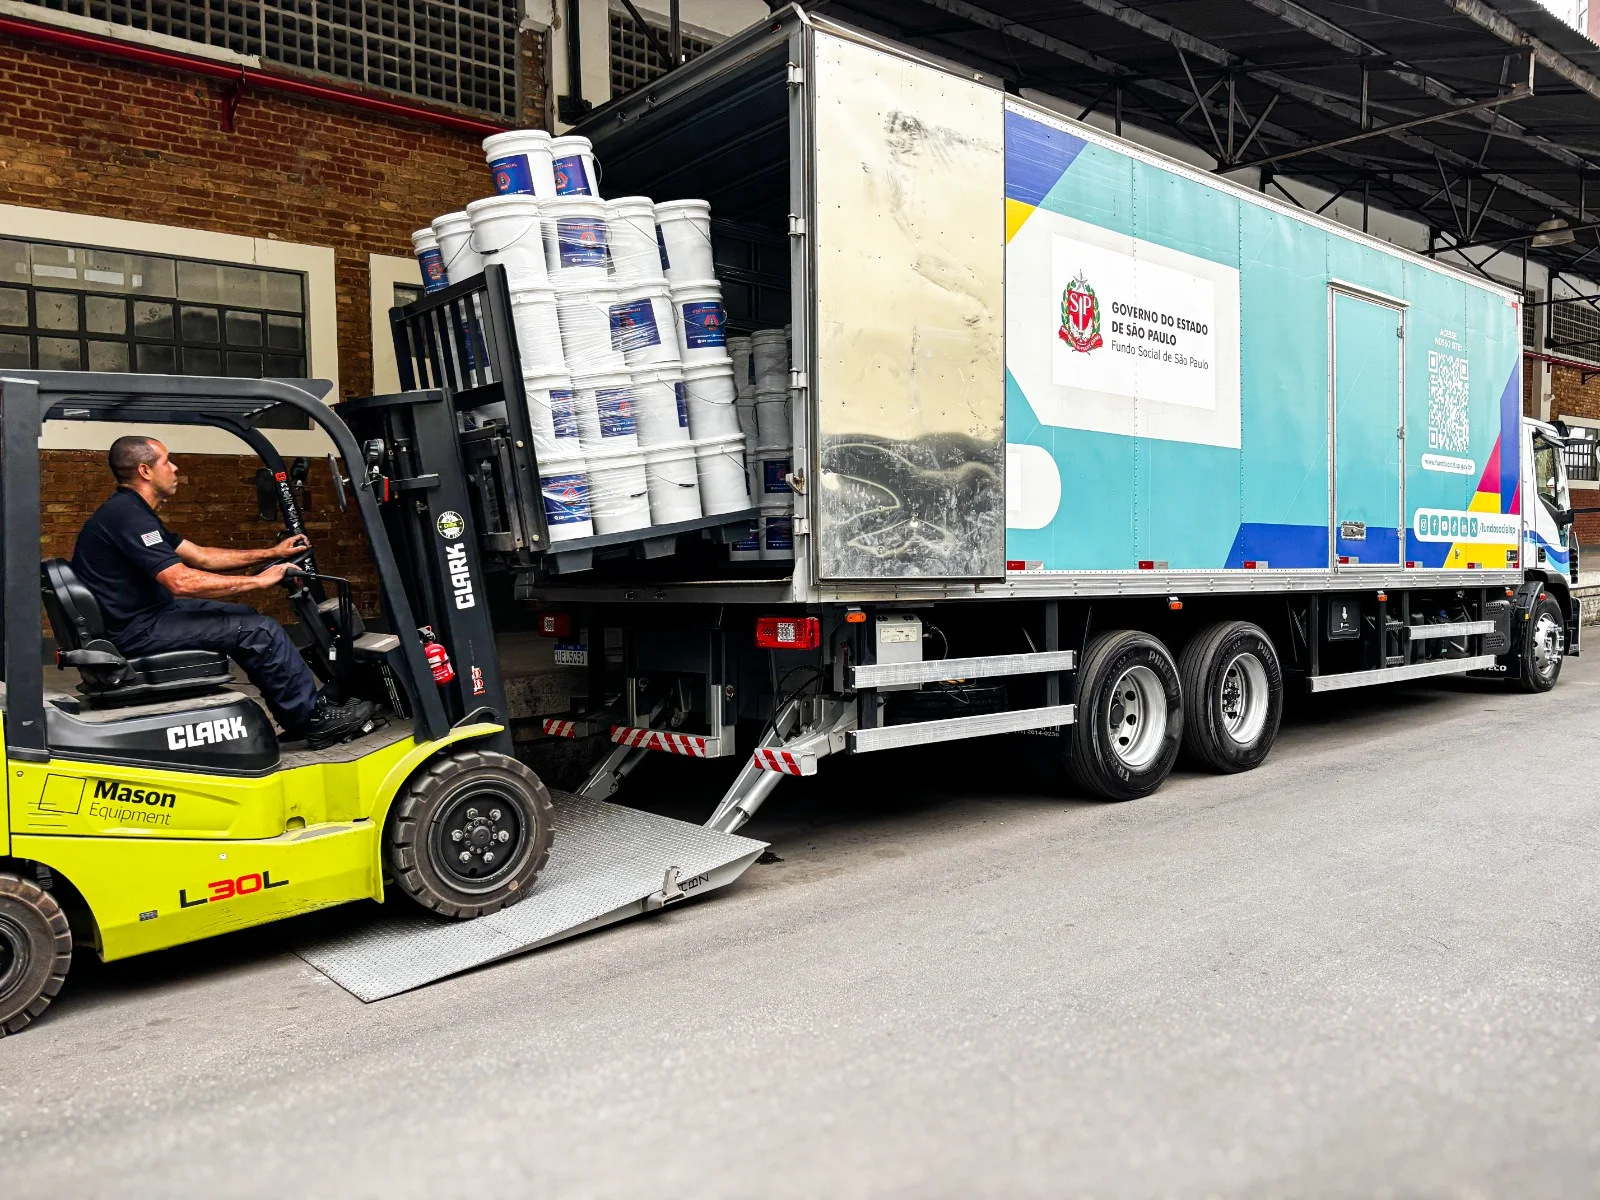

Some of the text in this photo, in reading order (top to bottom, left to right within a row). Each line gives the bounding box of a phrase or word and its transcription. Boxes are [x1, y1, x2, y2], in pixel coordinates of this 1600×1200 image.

[1111, 302, 1208, 336] GOVERNO DO ESTADO
[1111, 321, 1177, 346] DE SÃO PAULO
[1111, 340, 1209, 370] Fundo Social de São Paulo
[445, 542, 476, 610] CLARK
[166, 715, 248, 751] CLARK
[93, 779, 177, 808] Mason
[89, 801, 172, 826] Equipment
[179, 870, 289, 908] L30L
